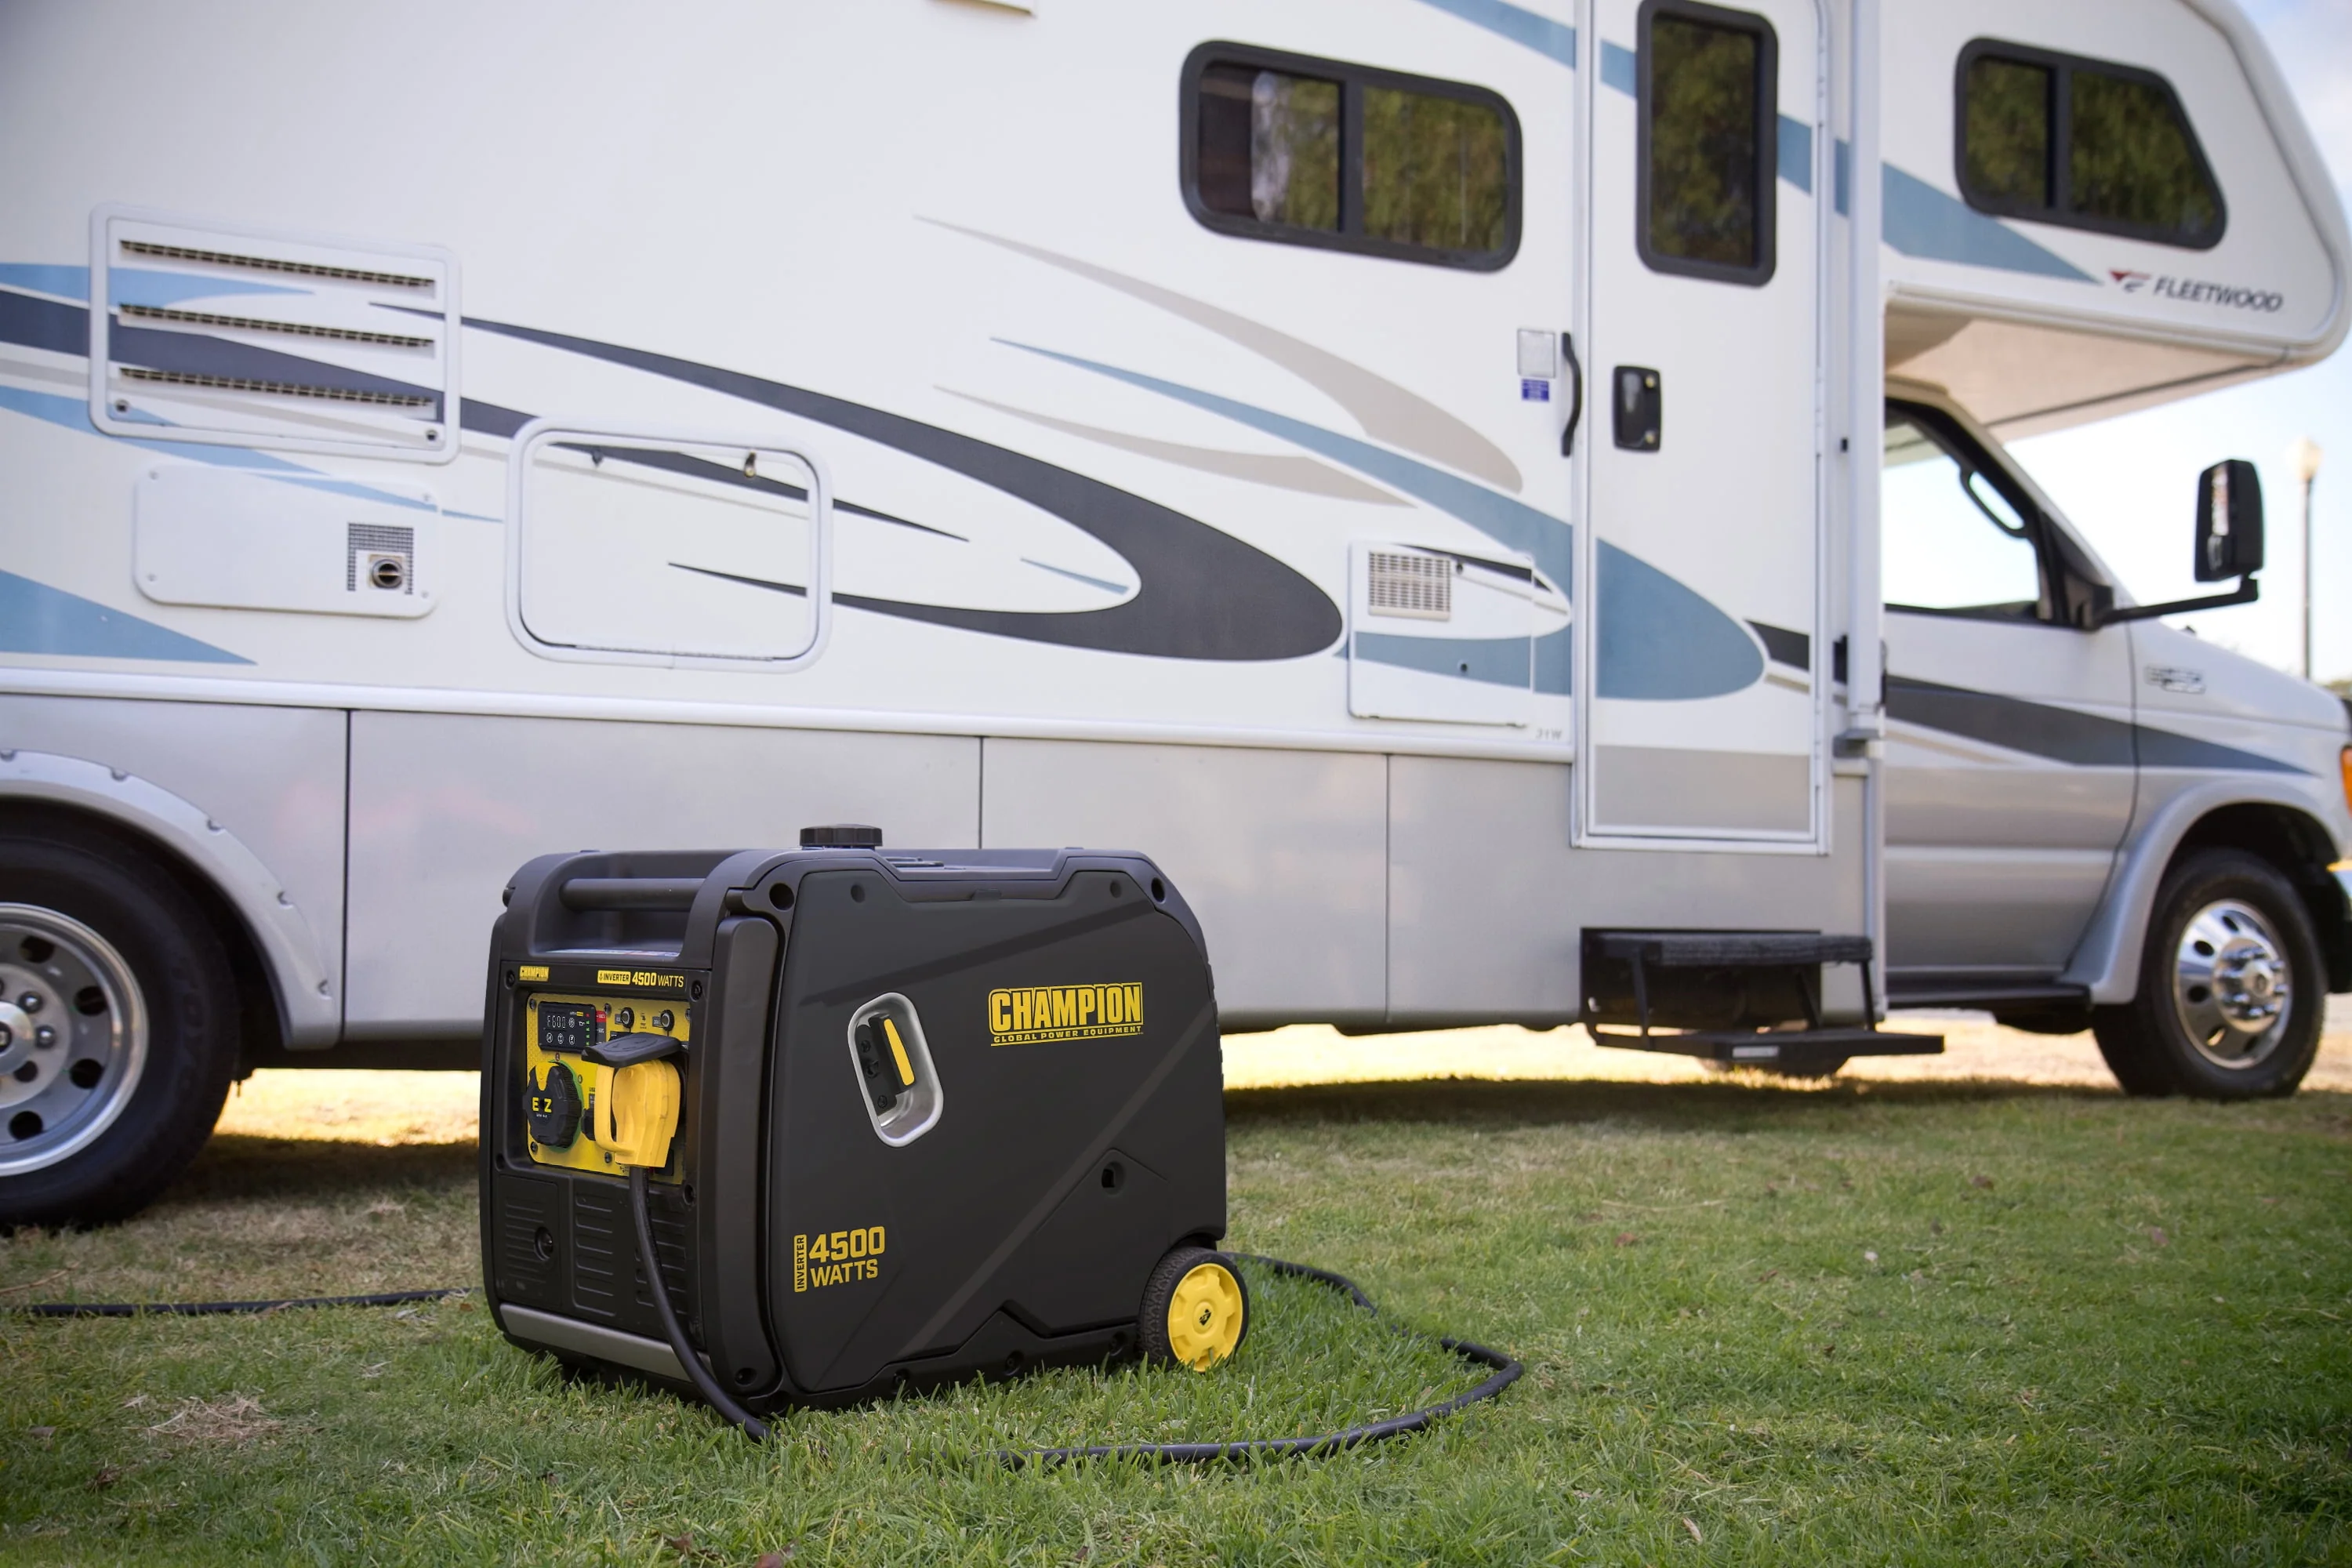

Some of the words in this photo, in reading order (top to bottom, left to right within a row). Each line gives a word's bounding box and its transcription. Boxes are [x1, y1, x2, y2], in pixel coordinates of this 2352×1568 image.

[2154, 276, 2284, 312] FLEETWOOD
[519, 965, 550, 978] CHAMPION
[604, 973, 630, 982] INVERTER
[631, 971, 657, 986] 4500
[658, 975, 684, 988] WATTS
[991, 985, 1142, 1032] CHAMPION
[993, 1033, 1037, 1044] GLOBAL
[1040, 1030, 1079, 1040] POWER
[1083, 1025, 1142, 1036] EQUIPMENT
[808, 1225, 885, 1263] 4500
[796, 1236, 804, 1289] INVERTER
[810, 1258, 878, 1288] WATTS
